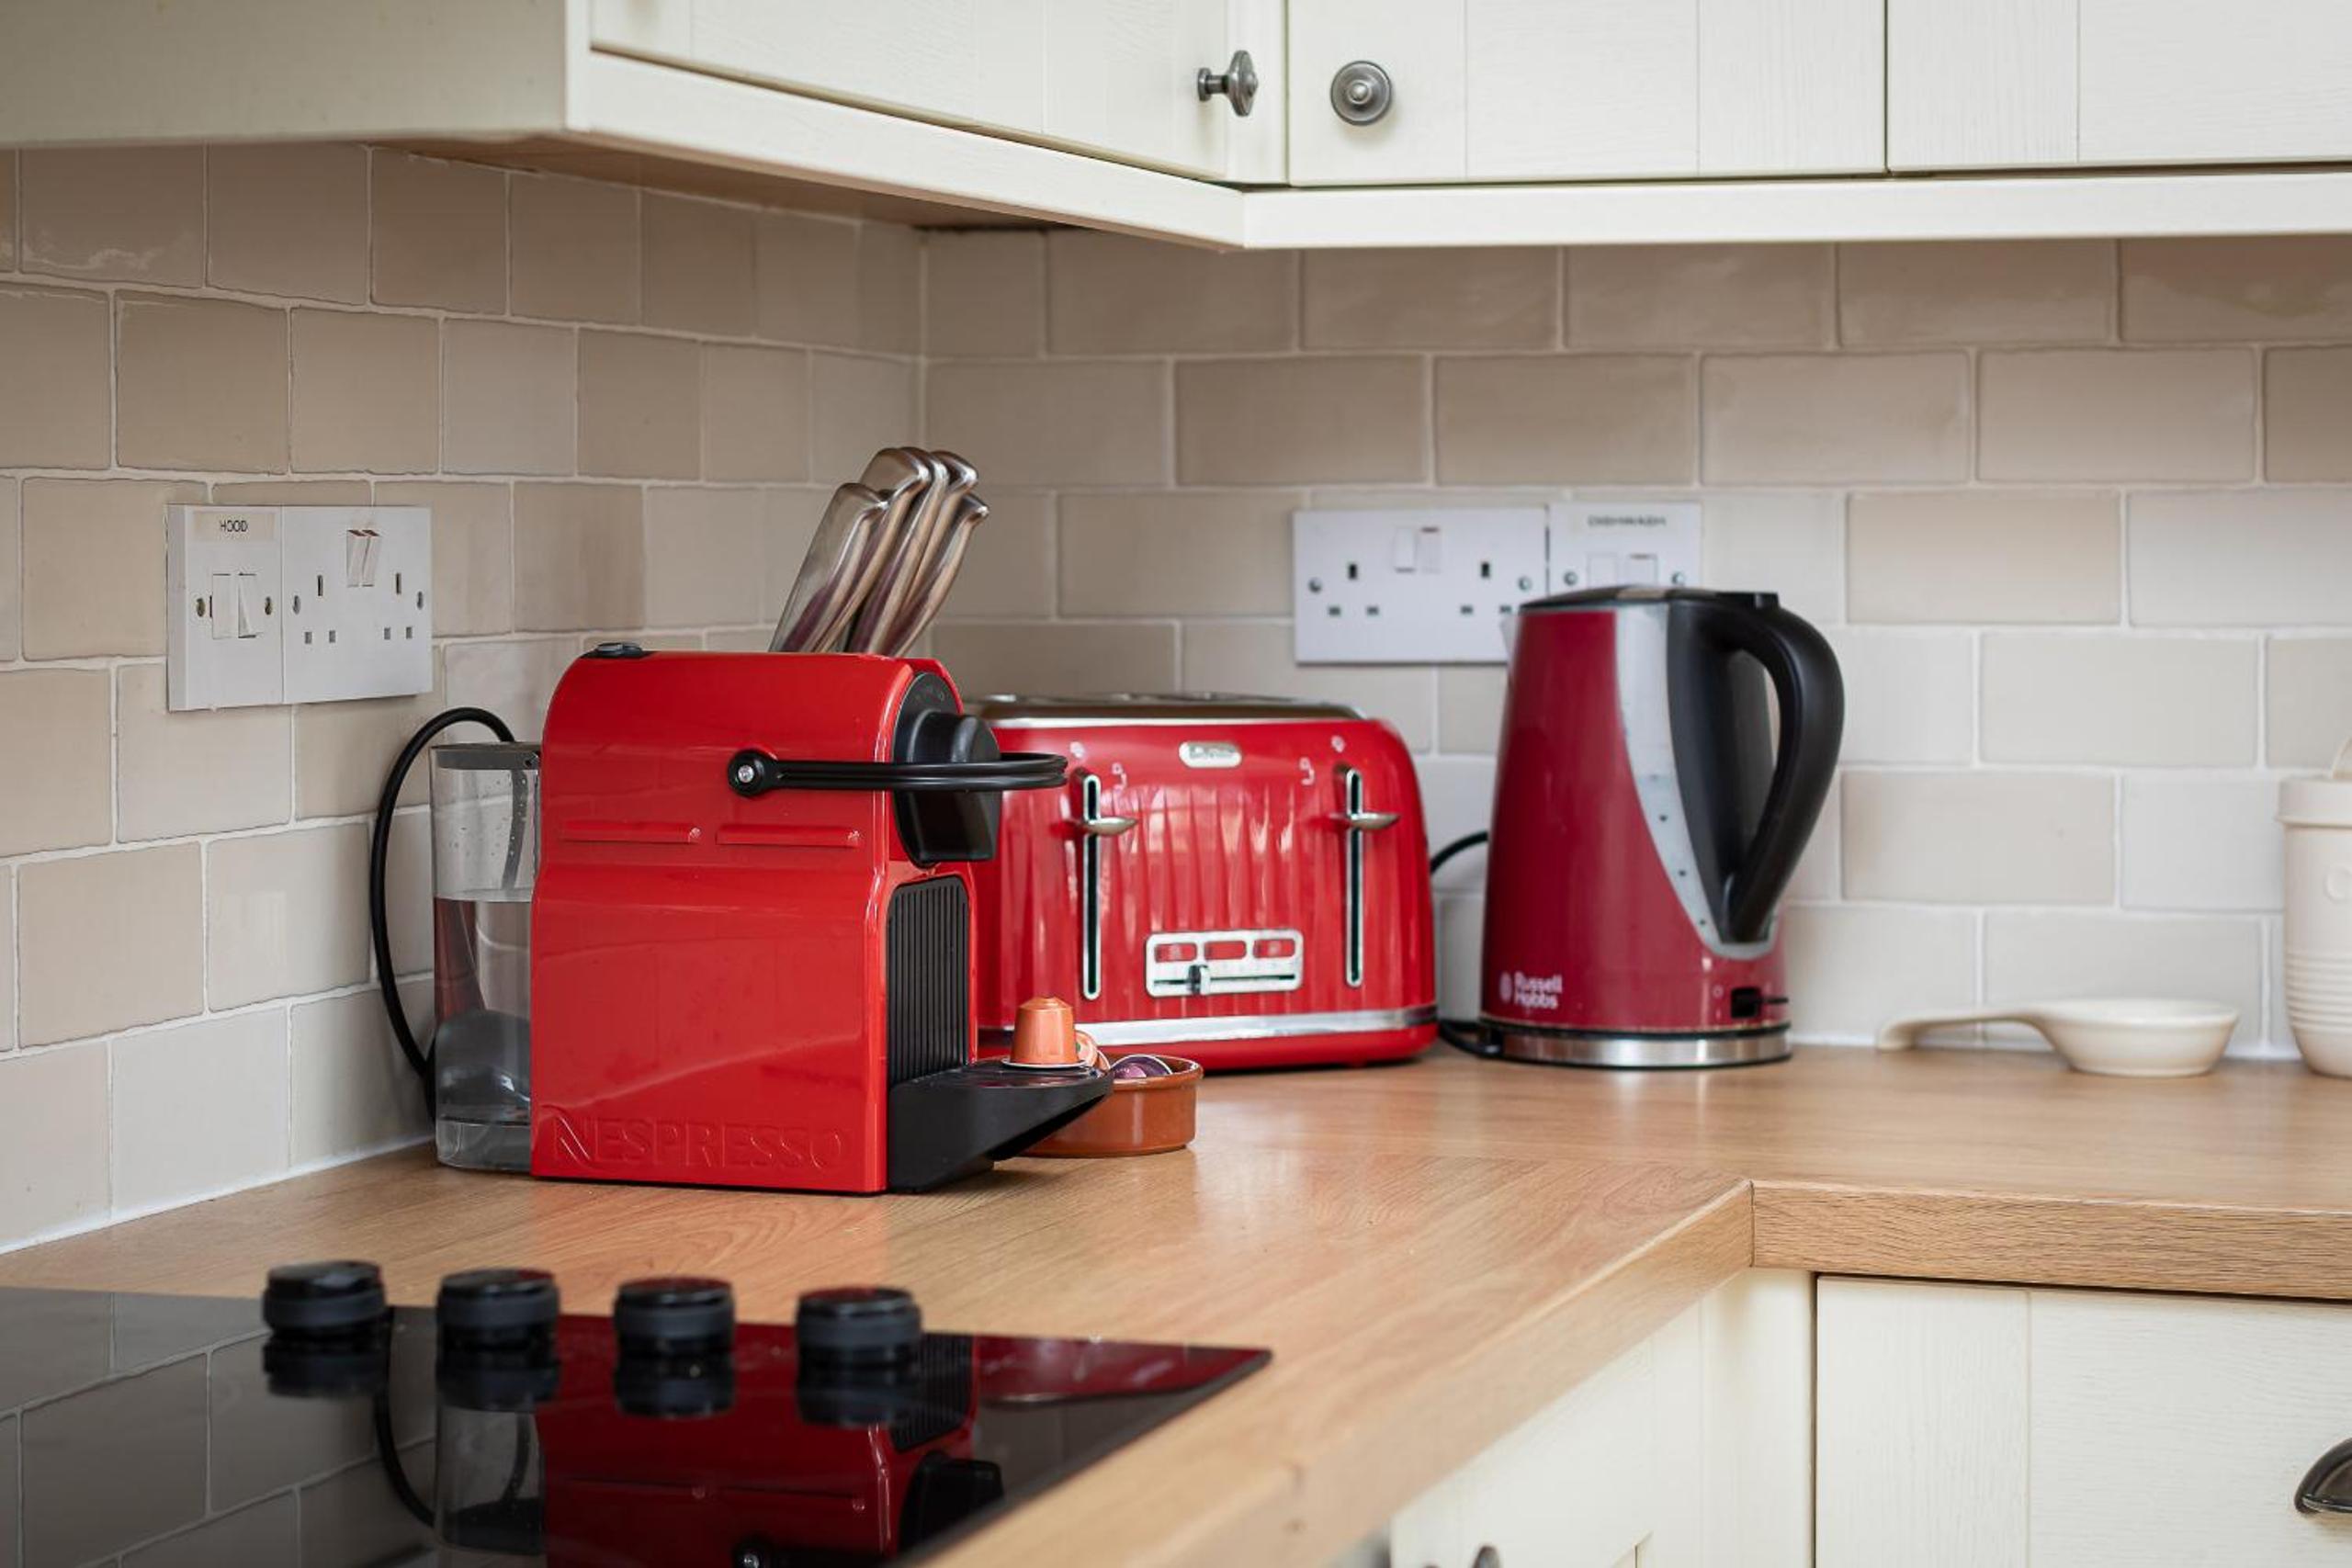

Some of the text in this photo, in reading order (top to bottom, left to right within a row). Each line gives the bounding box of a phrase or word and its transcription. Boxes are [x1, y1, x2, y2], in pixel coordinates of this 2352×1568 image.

[220, 519, 248, 533] HOOD
[1514, 972, 1563, 993] Russell
[1514, 991, 1558, 1010] Hobbs
[540, 1103, 849, 1172] NESPRESSO
